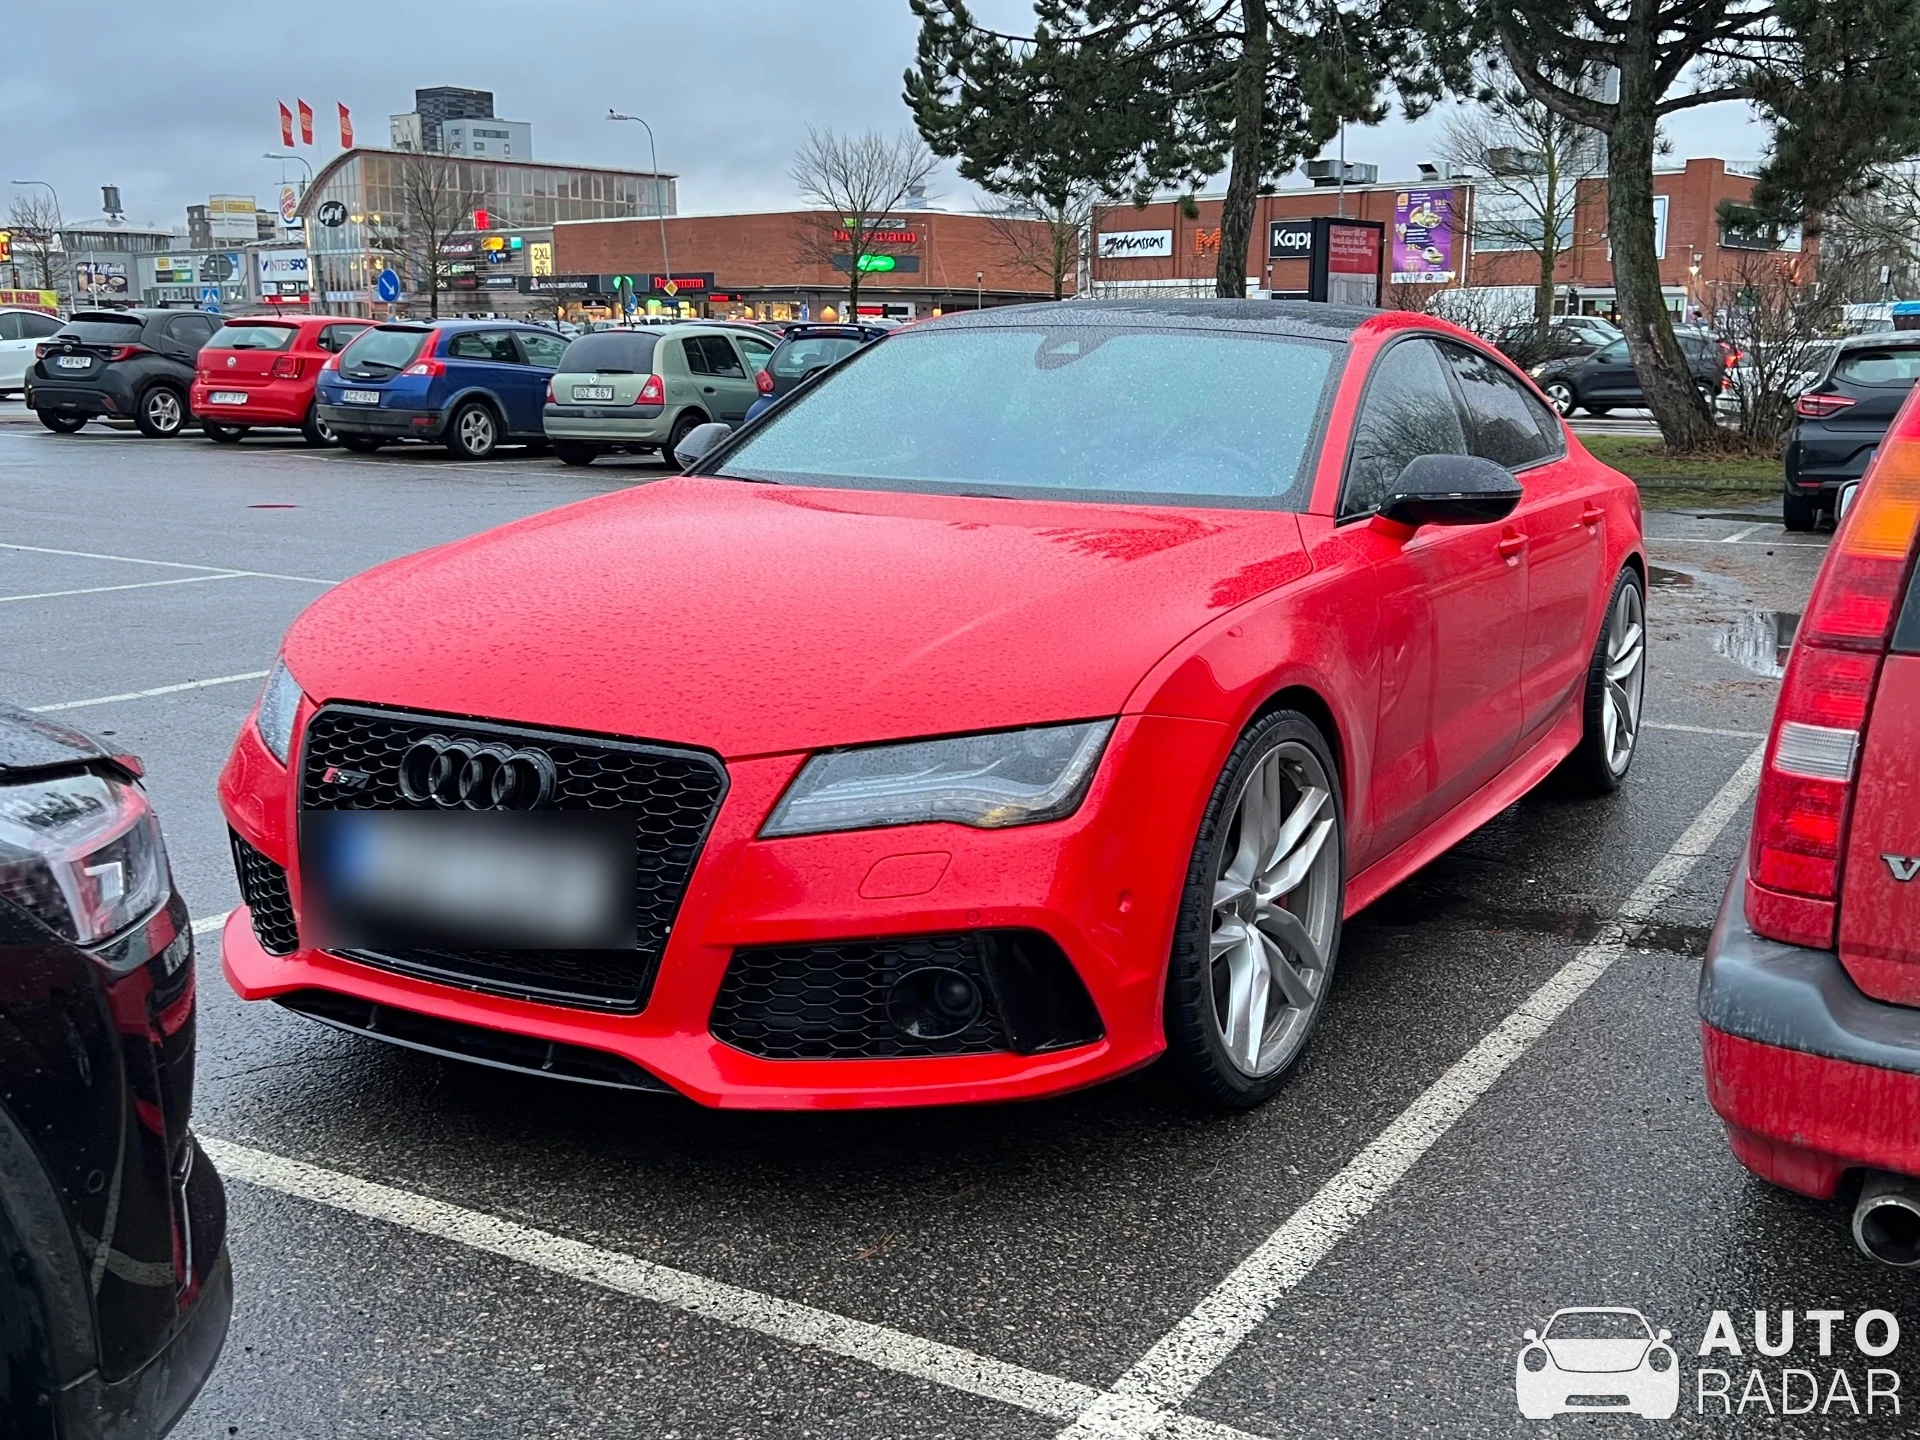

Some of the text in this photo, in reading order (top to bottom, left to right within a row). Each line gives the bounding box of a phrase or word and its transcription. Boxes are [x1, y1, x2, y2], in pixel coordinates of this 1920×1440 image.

[534, 247, 550, 260] 2XL
[654, 277, 704, 288] Drsmann
[595, 388, 611, 398] 667
[322, 766, 370, 789] RS7
